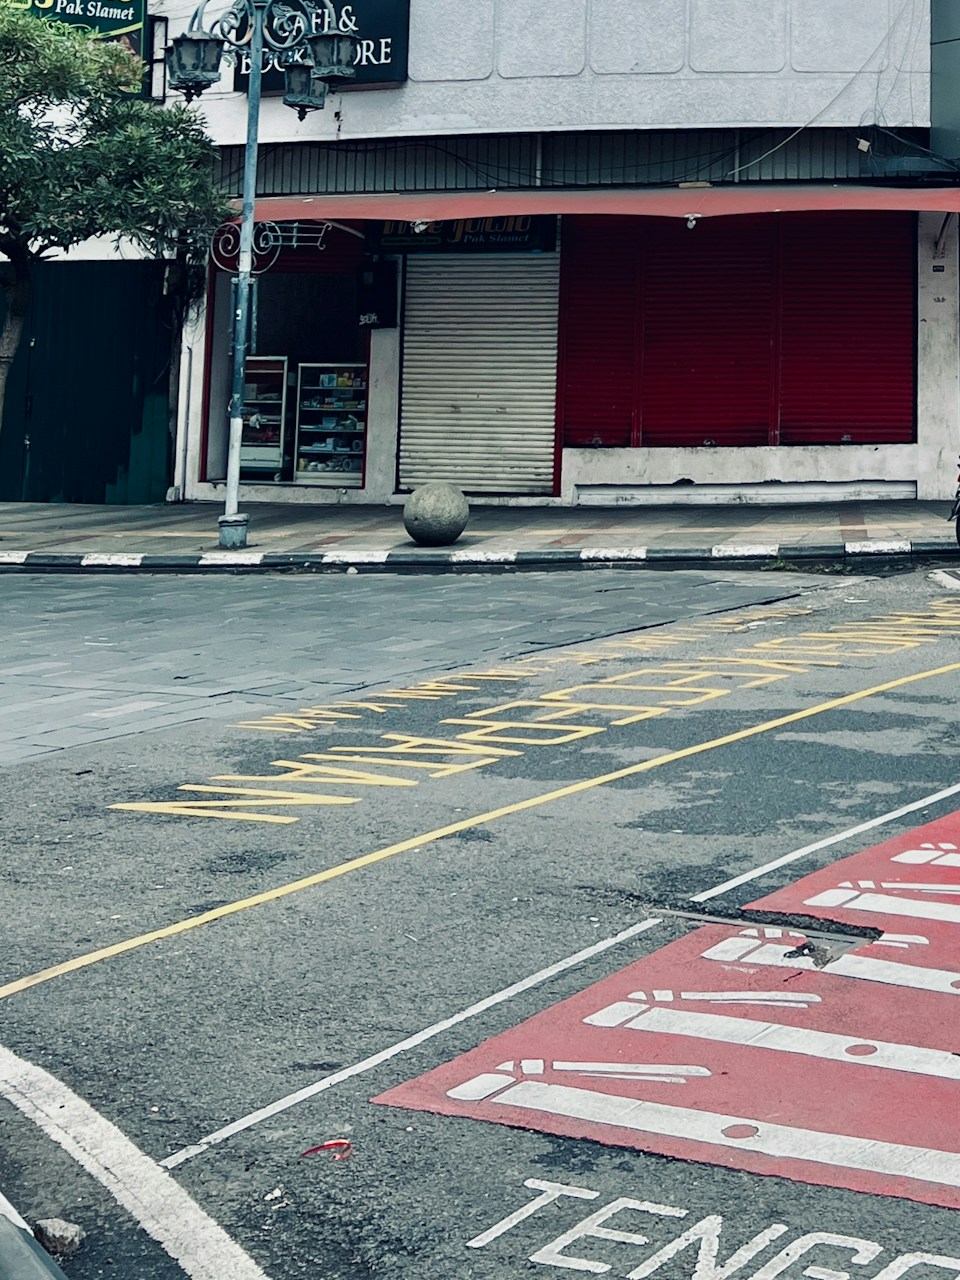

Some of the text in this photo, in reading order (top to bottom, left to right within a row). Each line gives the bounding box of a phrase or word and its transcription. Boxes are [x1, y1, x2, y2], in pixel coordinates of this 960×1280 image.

[87, 0, 135, 21] Slamet
[338, 5, 359, 32] &
[463, 234, 486, 243] Pak
[108, 656, 842, 824] KECEPATAN
